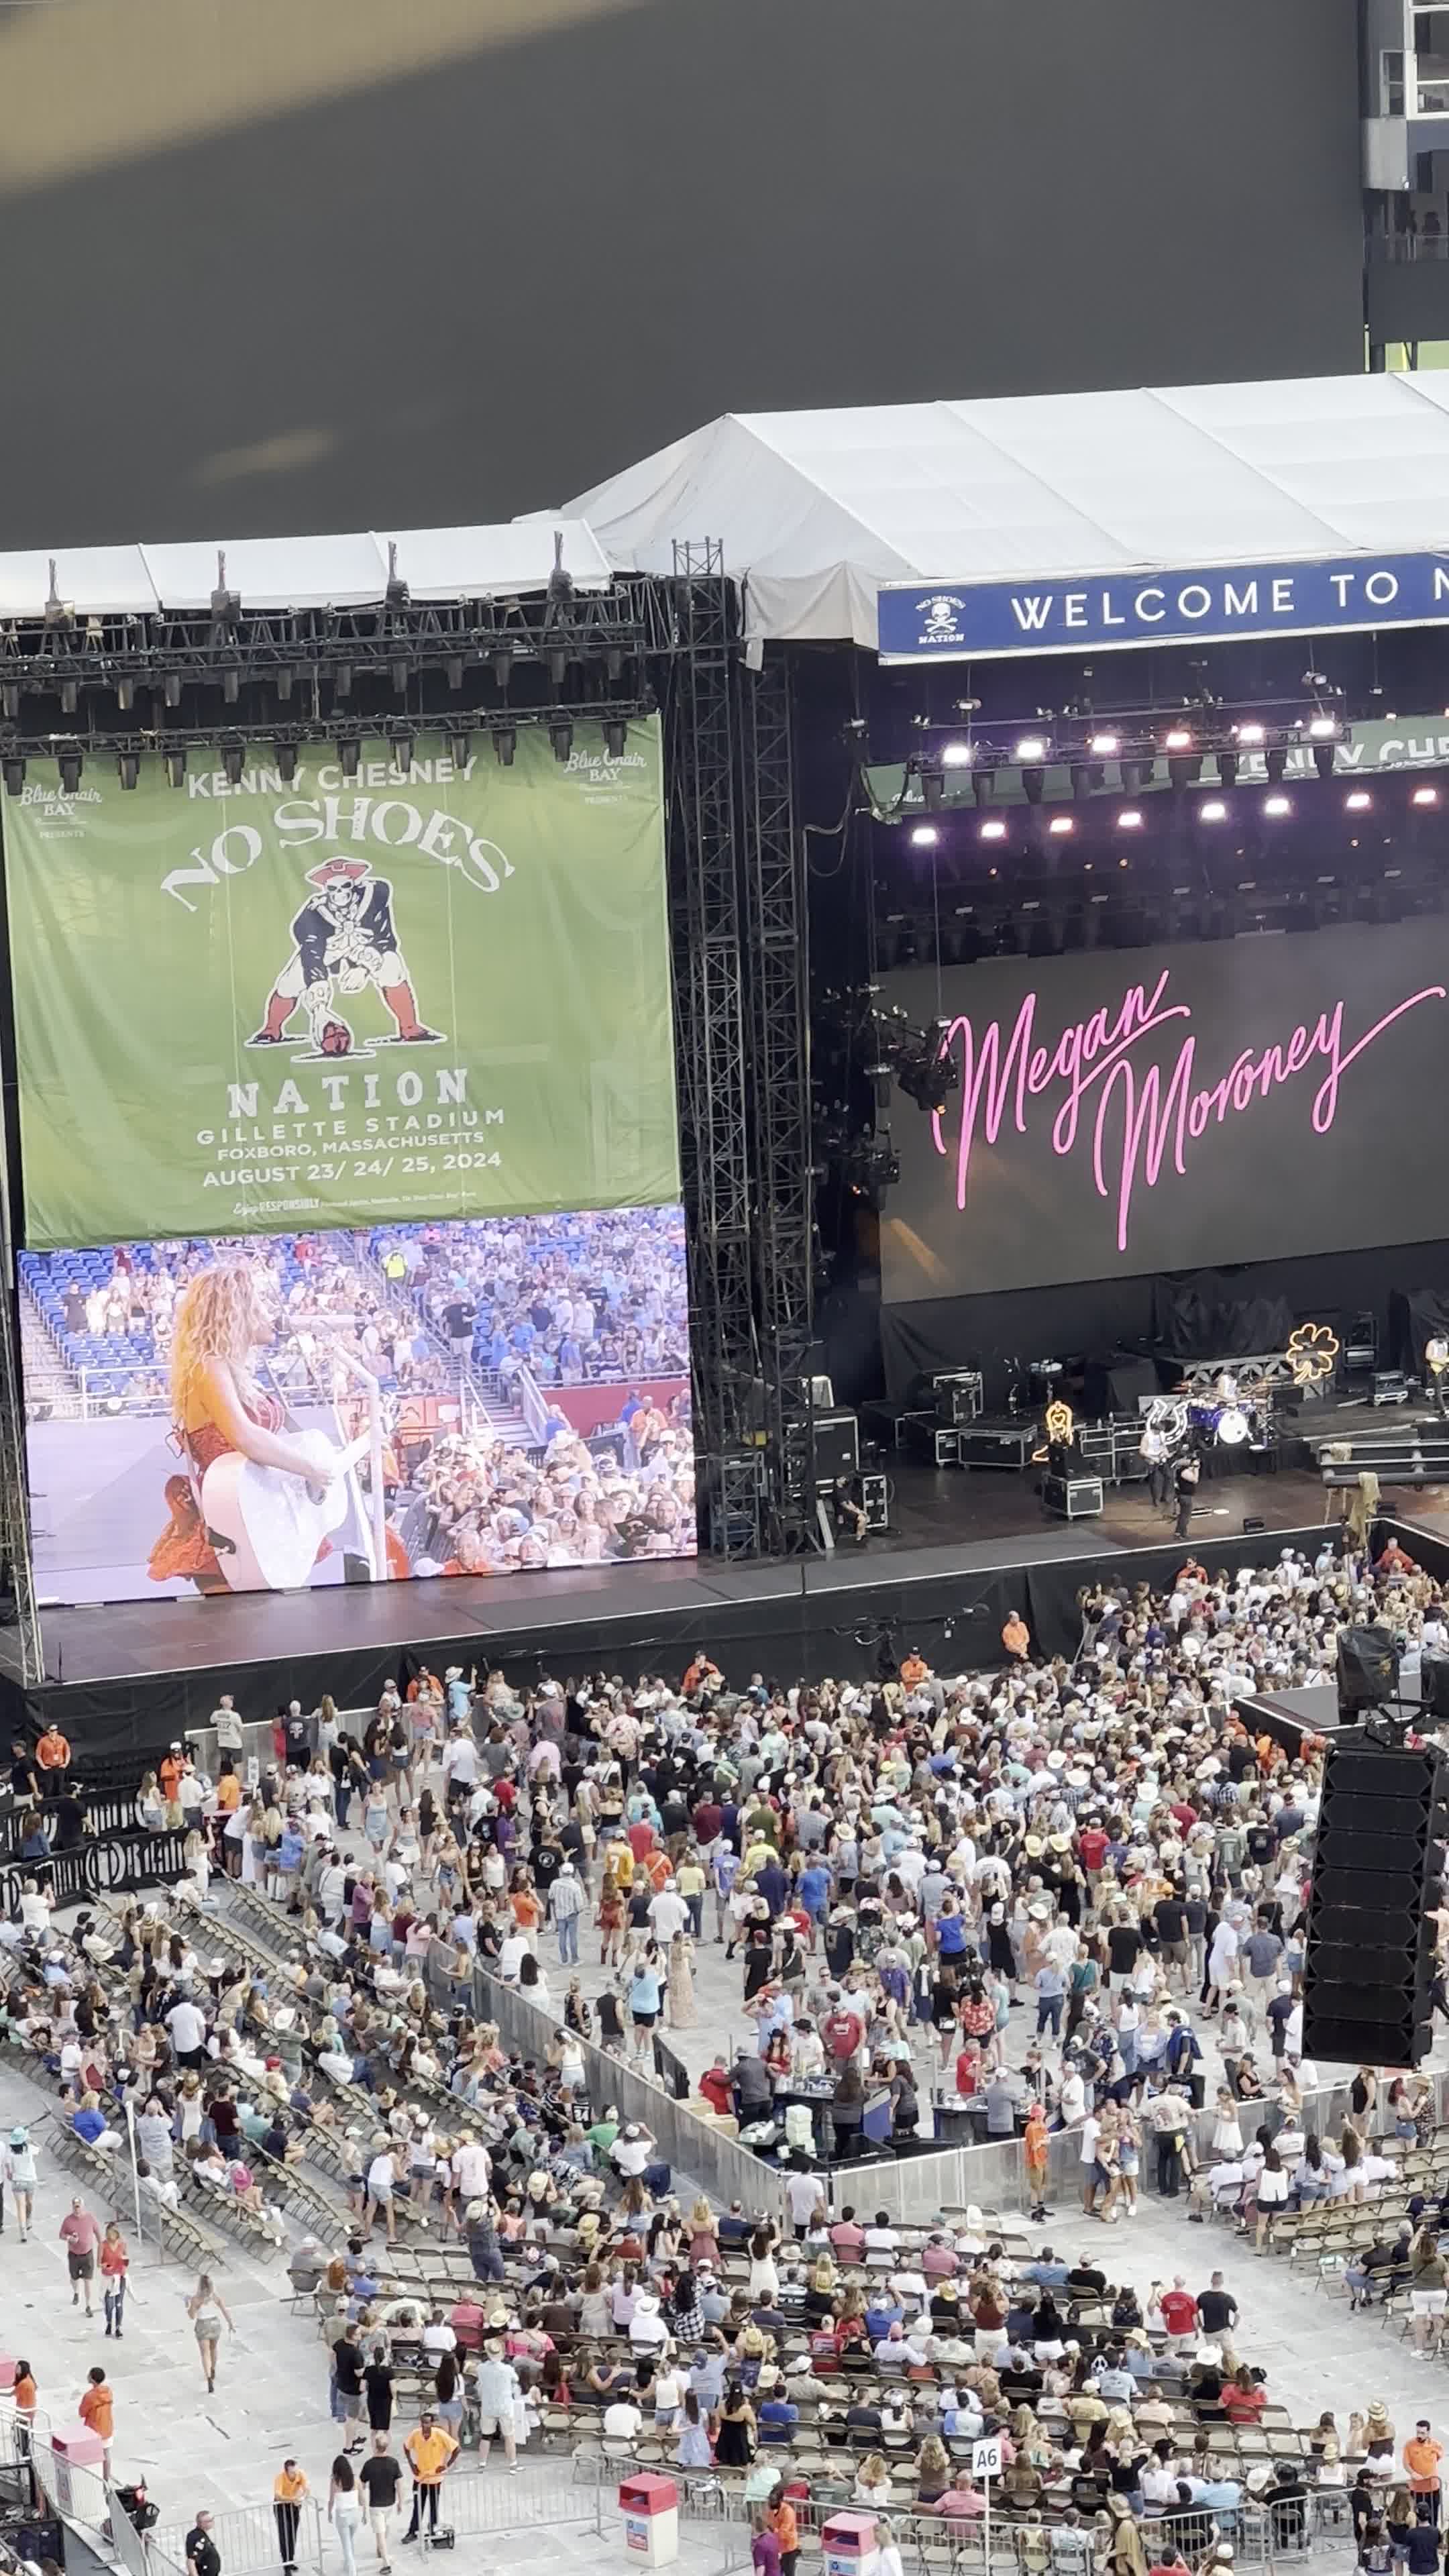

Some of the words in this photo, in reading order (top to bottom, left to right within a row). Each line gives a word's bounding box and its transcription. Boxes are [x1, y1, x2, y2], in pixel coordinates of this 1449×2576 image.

[1012, 579, 1295, 630] WELCOME
[1330, 572, 1399, 606] TO
[918, 633, 965, 644] NATION
[189, 767, 306, 798] KENNY
[317, 756, 478, 790] CHESNEY
[564, 749, 602, 773] Blue
[590, 767, 621, 782] BAY
[18, 784, 56, 806] Blue
[43, 803, 75, 816] BAY
[160, 825, 262, 912] NO
[274, 796, 515, 893] SHOES
[227, 1068, 467, 1118] NATION
[932, 970, 1191, 1210] Megan
[1093, 986, 1446, 1250] Moroney
[197, 1120, 347, 1144] GILLETTE
[365, 1109, 505, 1133] STADIUM
[217, 1144, 317, 1161] FOXBORO,
[322, 1132, 484, 1154] MASSACHUSETTS
[203, 1166, 300, 1187] AUGUST
[306, 1161, 347, 1181] 23/
[354, 1157, 394, 1177] 24/
[402, 1157, 436, 1175] 25,
[442, 1151, 502, 1170] 2024
[977, 2448, 997, 2468] A6
